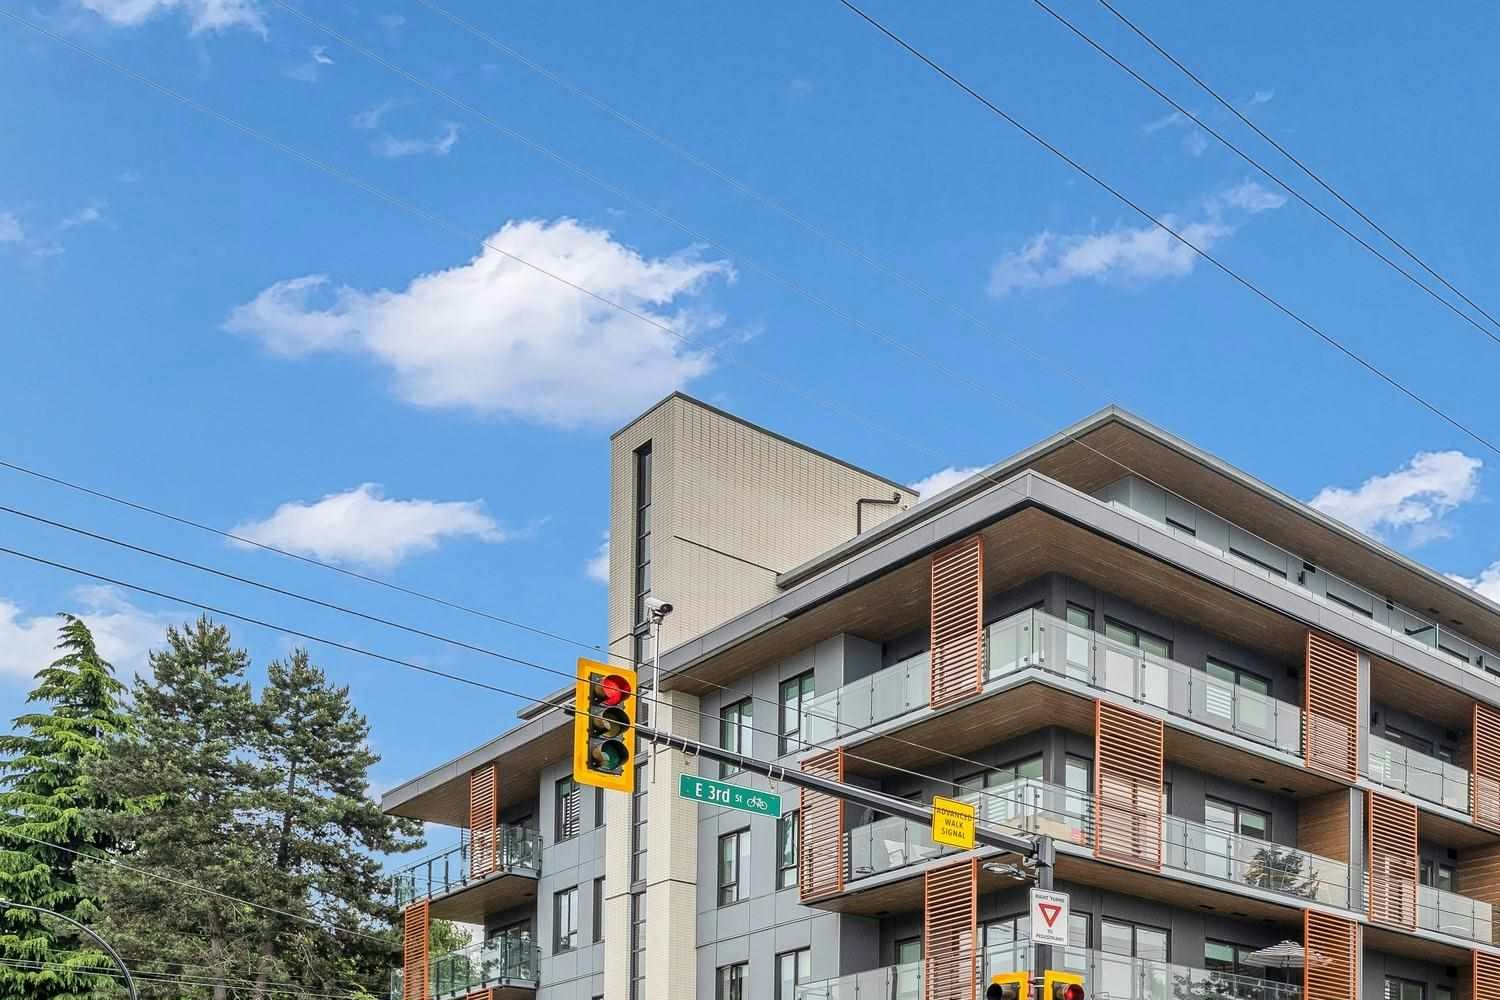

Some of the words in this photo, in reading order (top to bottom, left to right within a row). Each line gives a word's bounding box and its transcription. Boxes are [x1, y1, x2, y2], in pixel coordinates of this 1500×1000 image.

[695, 783, 702, 797] E
[708, 785, 730, 803] 3rd
[945, 819, 963, 828] WALK
[942, 827, 966, 839] SIGNAL
